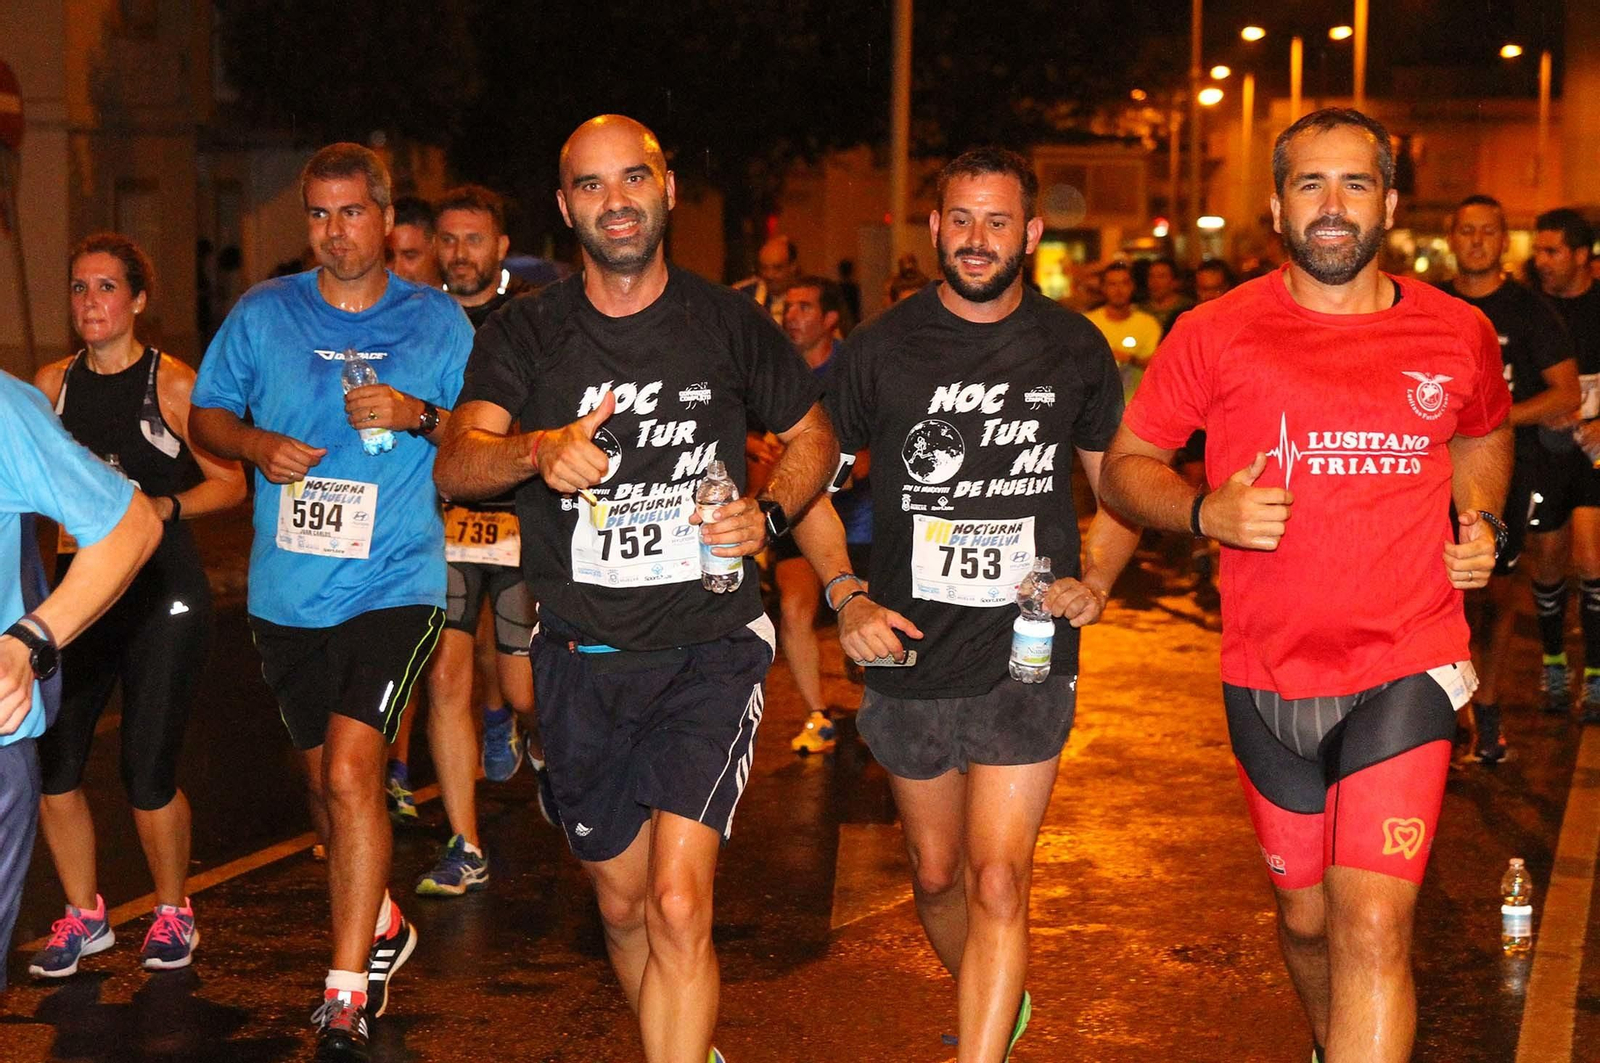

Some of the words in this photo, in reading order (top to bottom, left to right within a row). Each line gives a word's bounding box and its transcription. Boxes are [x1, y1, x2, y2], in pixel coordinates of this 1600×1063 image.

[577, 380, 662, 417] NOC
[928, 381, 1009, 414] NOC
[636, 419, 697, 448] TUR
[980, 418, 1039, 447] TUR
[1307, 431, 1429, 450] LUSITANO
[671, 440, 719, 481] NA
[1009, 443, 1059, 476] NA
[1307, 457, 1421, 475] TRIATLO
[300, 490, 316, 500] DE
[318, 492, 362, 504] HUELVA
[304, 480, 365, 494] NOCTURNA
[614, 482, 646, 499] DE
[953, 480, 984, 498] DE
[985, 475, 1053, 498] HUELVA
[293, 500, 343, 532] 594
[608, 495, 682, 517] NOCTURNA
[605, 515, 623, 528] DE
[628, 508, 680, 527] HUELVA
[952, 522, 1023, 535] NOCTURNA
[457, 521, 498, 545] 739
[597, 524, 663, 561] 752
[950, 535, 966, 545] DE
[971, 534, 1019, 547] HUELVA
[939, 545, 1002, 580] 753
